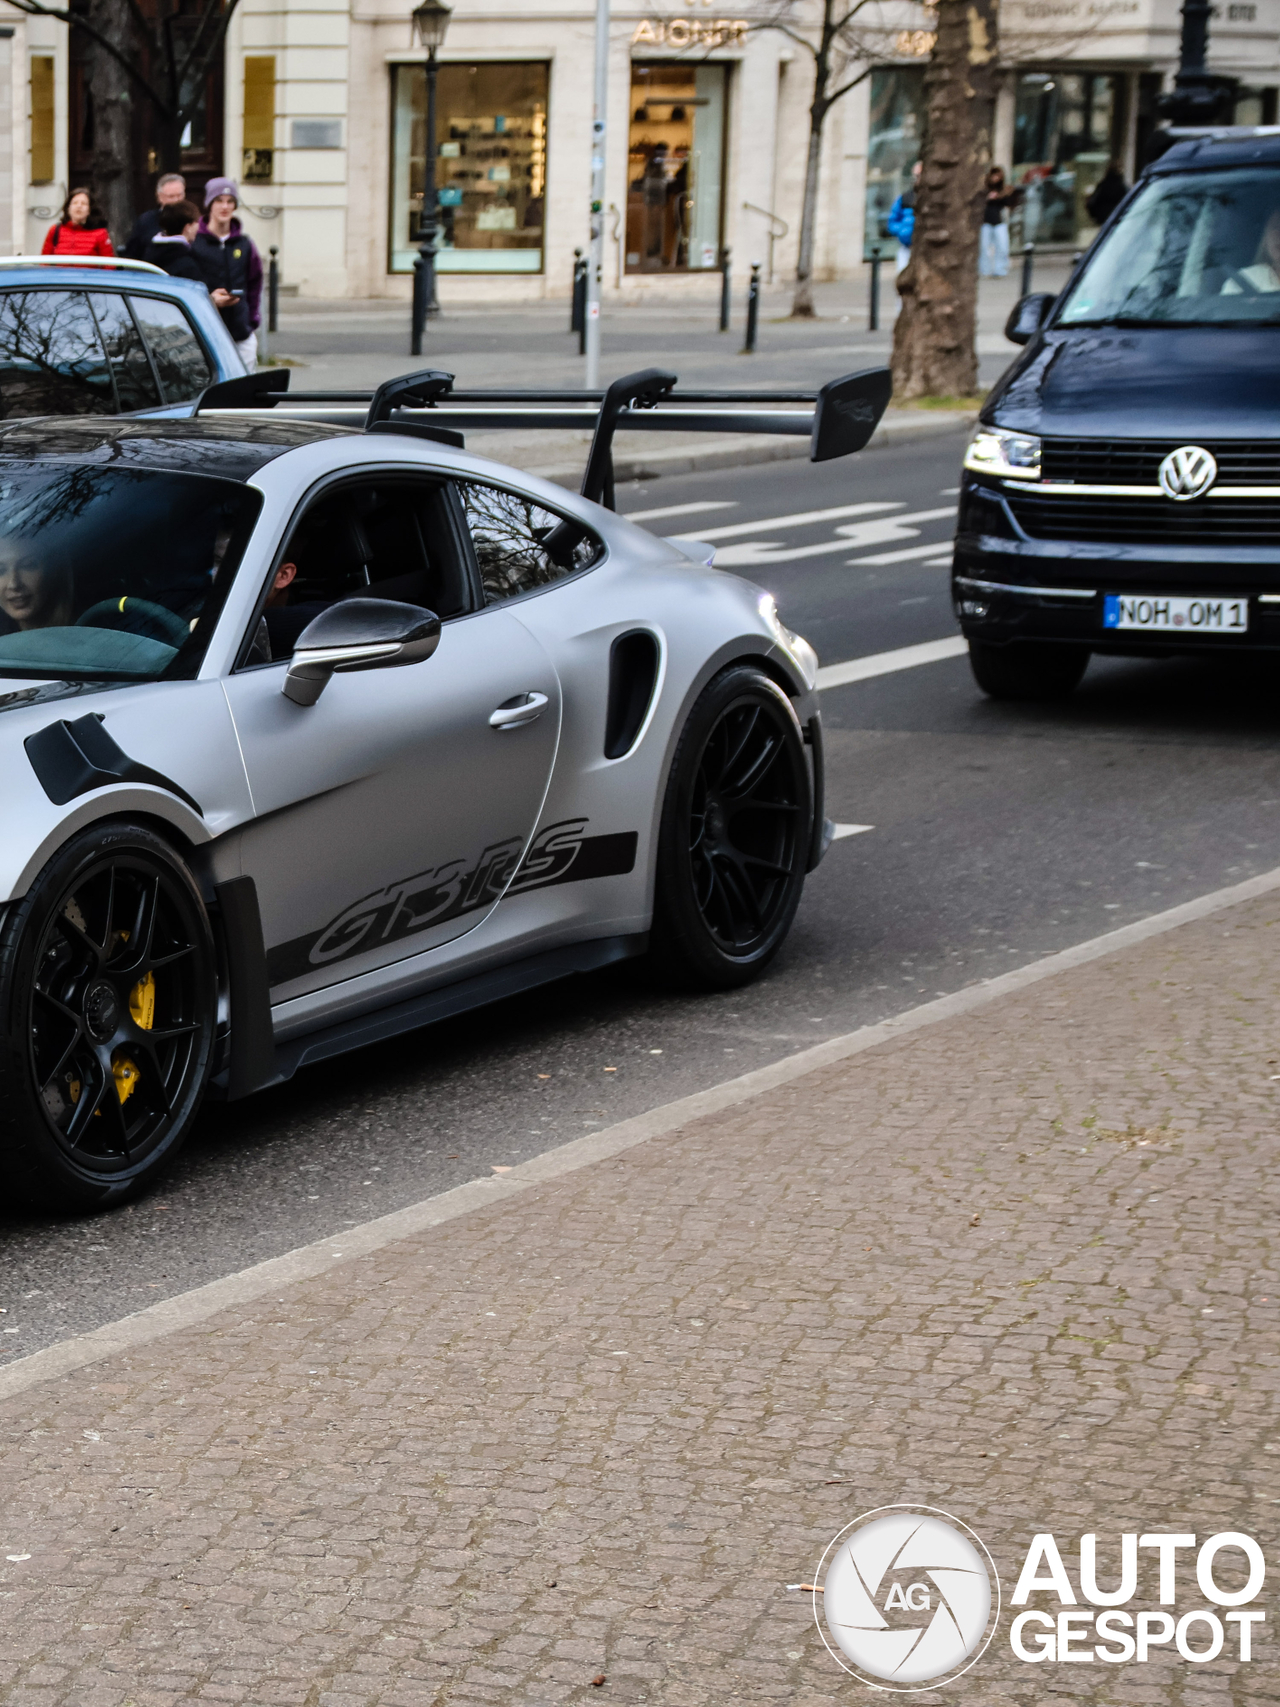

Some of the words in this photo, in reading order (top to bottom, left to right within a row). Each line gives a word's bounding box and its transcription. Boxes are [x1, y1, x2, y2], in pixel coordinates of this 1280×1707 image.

[1158, 446, 1217, 501] VW
[1120, 600, 1170, 624] NOH
[1188, 602, 1223, 626] OM
[1229, 603, 1245, 627] 1
